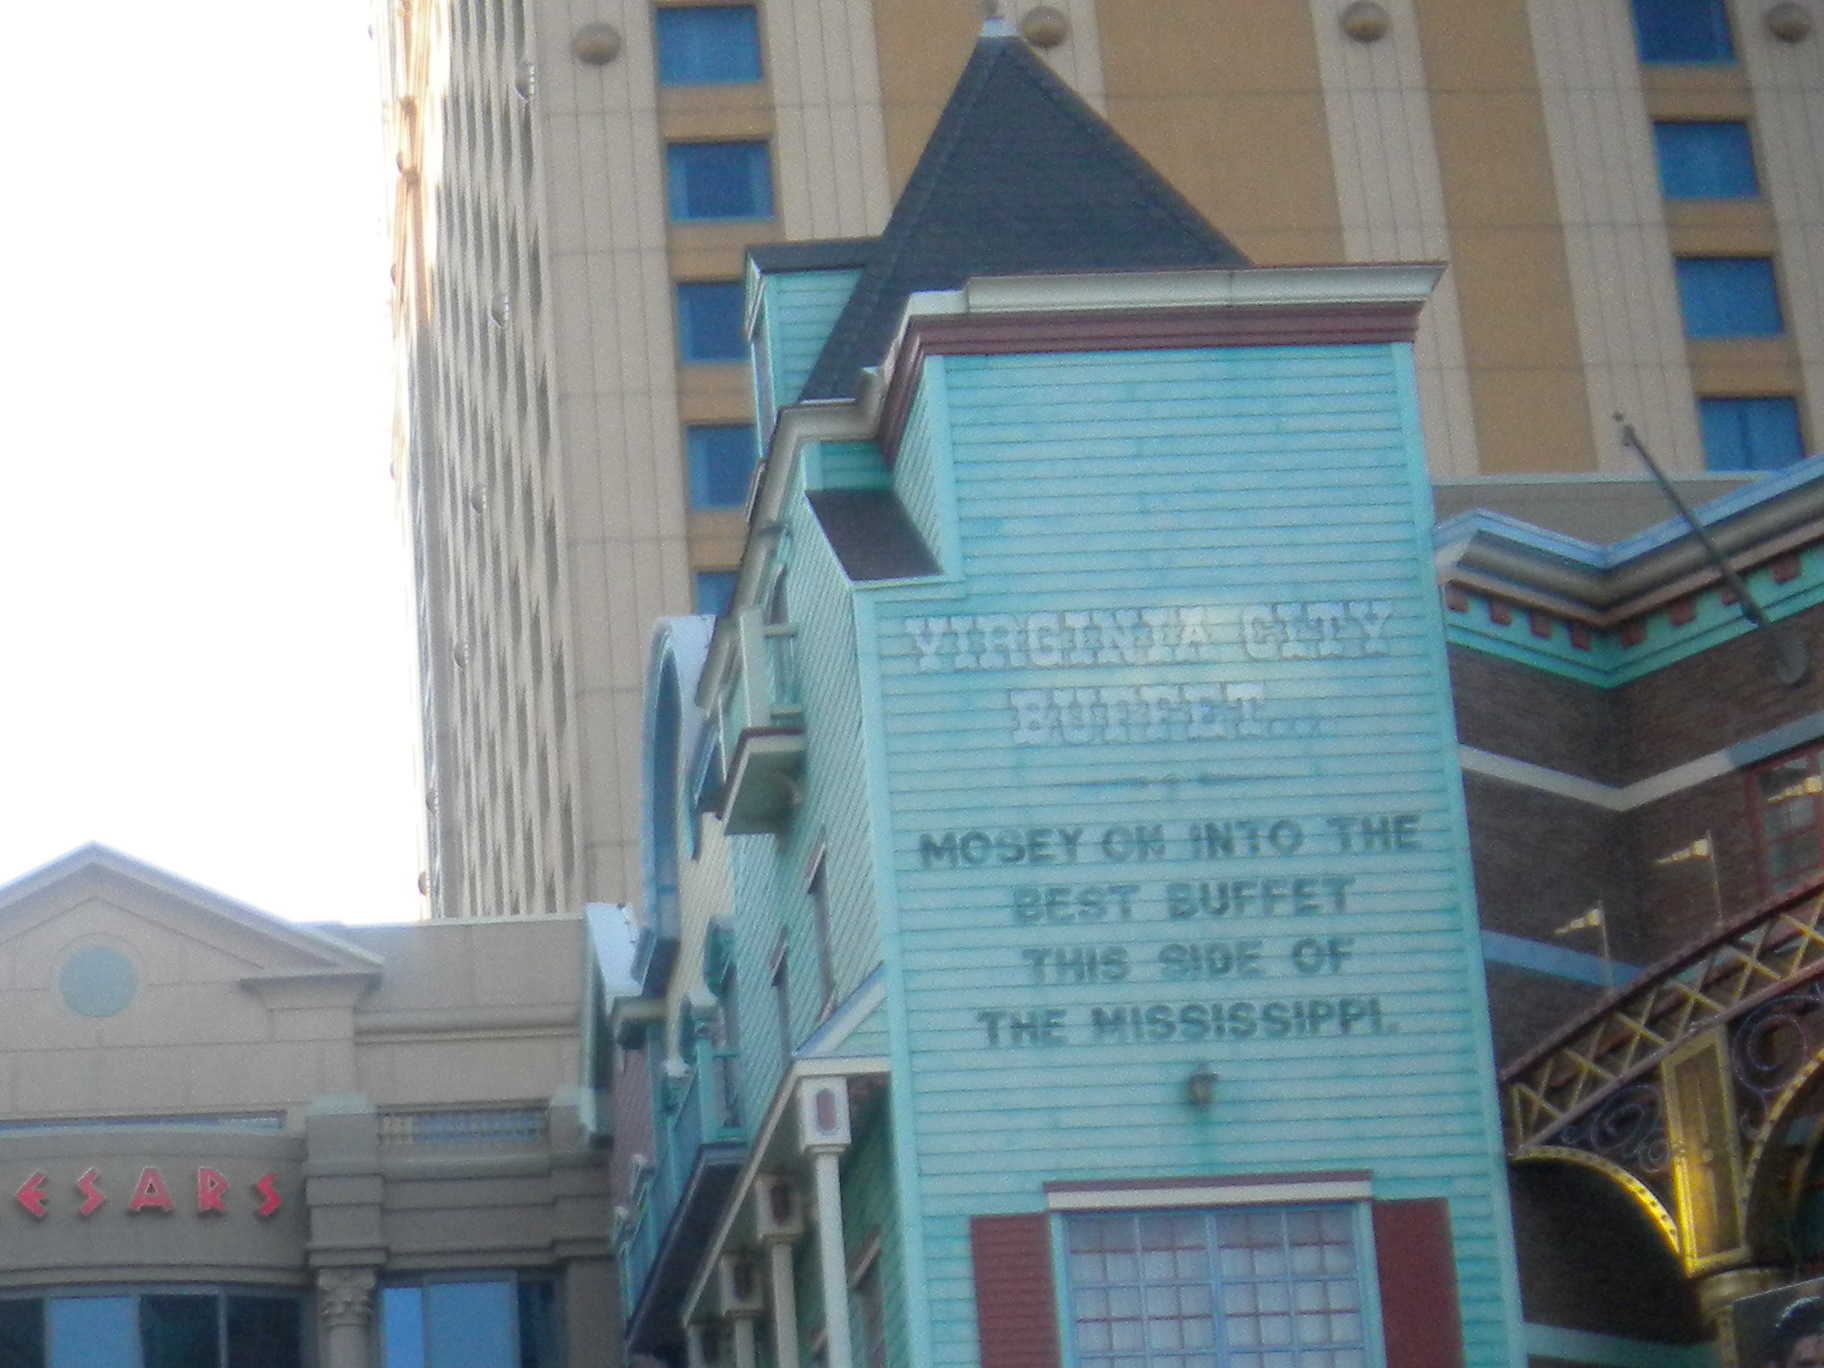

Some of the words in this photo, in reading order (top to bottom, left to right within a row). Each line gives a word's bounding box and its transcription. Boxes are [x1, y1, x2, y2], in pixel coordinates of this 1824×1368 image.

[905, 605, 1214, 674] VIRGINIA
[1242, 599, 1394, 662] CITY
[920, 826, 1084, 869] MOSEY
[1190, 818, 1303, 860] INTO
[1327, 814, 1422, 855] THE
[1013, 884, 1140, 925] BEST
[1168, 876, 1356, 918] BUFFET
[1022, 946, 1131, 982] THIS
[1159, 940, 1263, 978] SIDE
[1290, 936, 1355, 974] OF
[977, 1008, 1068, 1046] THE
